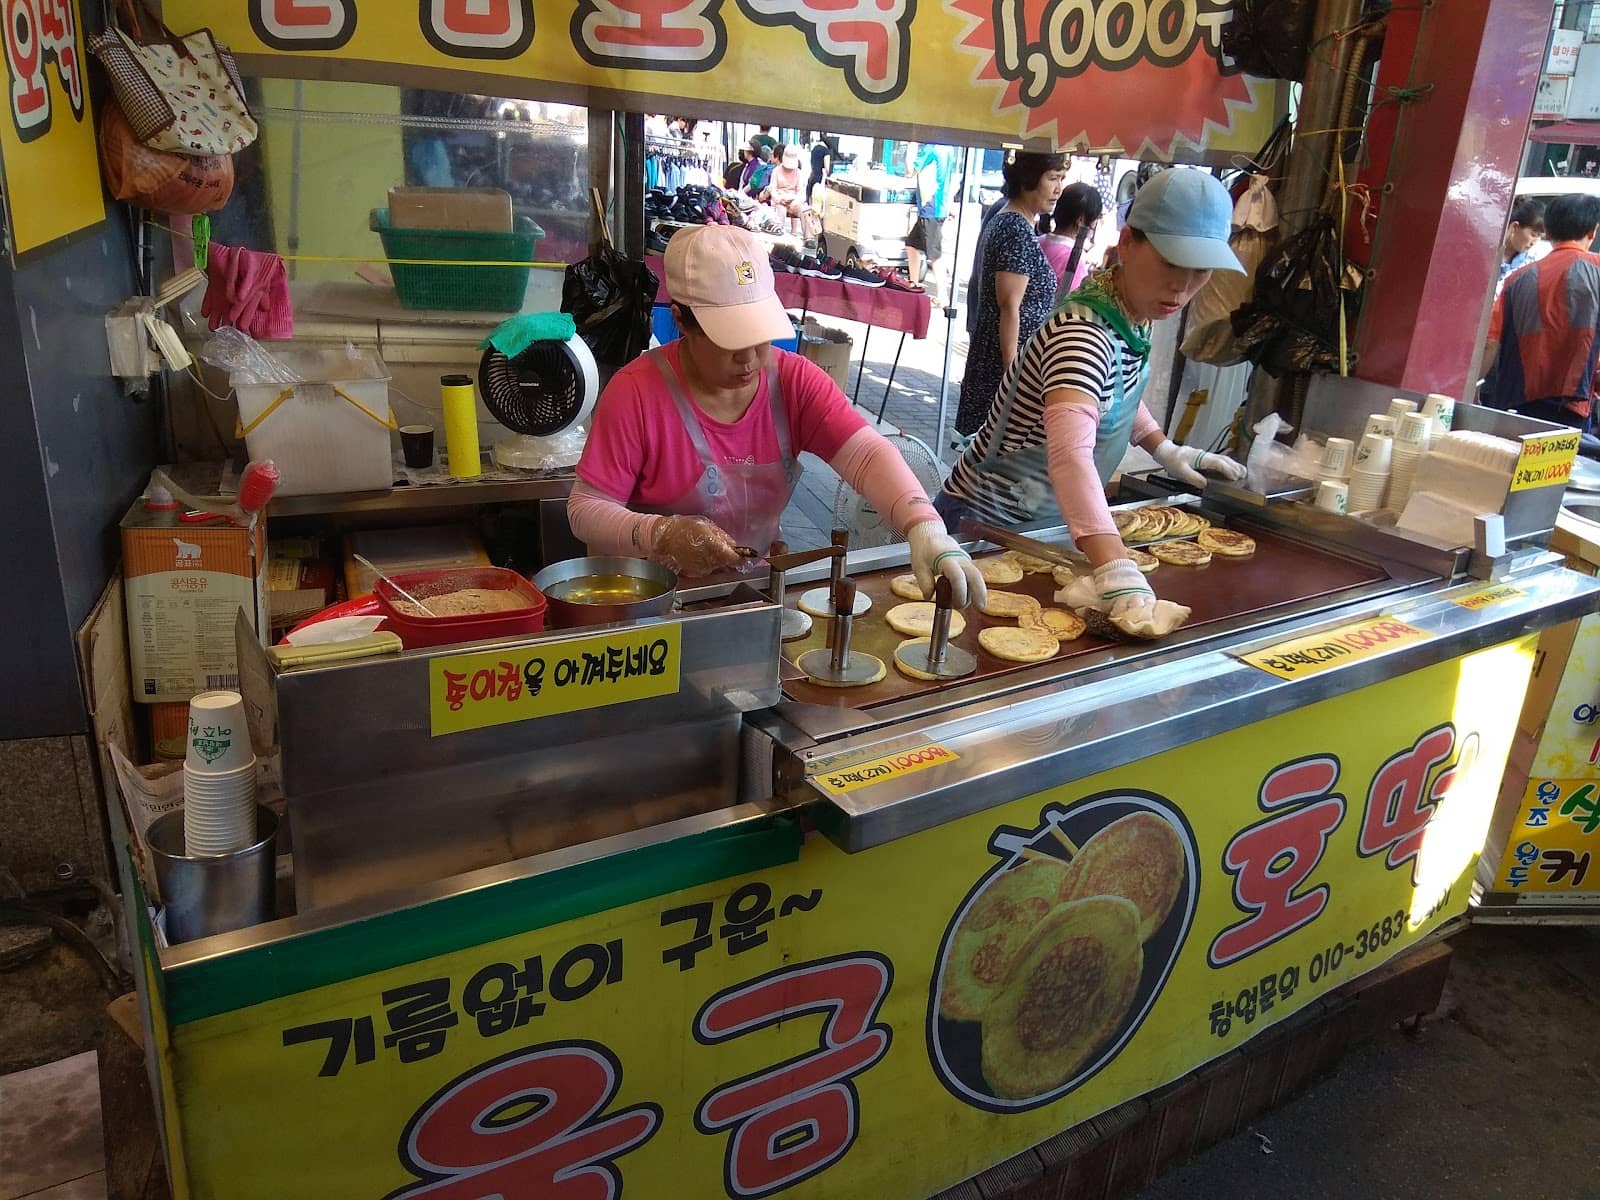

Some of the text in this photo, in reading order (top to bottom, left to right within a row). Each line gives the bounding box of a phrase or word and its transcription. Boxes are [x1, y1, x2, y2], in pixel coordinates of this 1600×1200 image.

[443, 639, 668, 711] 종이컵을 아껴주세요
[282, 938, 624, 1078] 기름없이
[1208, 966, 1301, 1038] 창업문의
